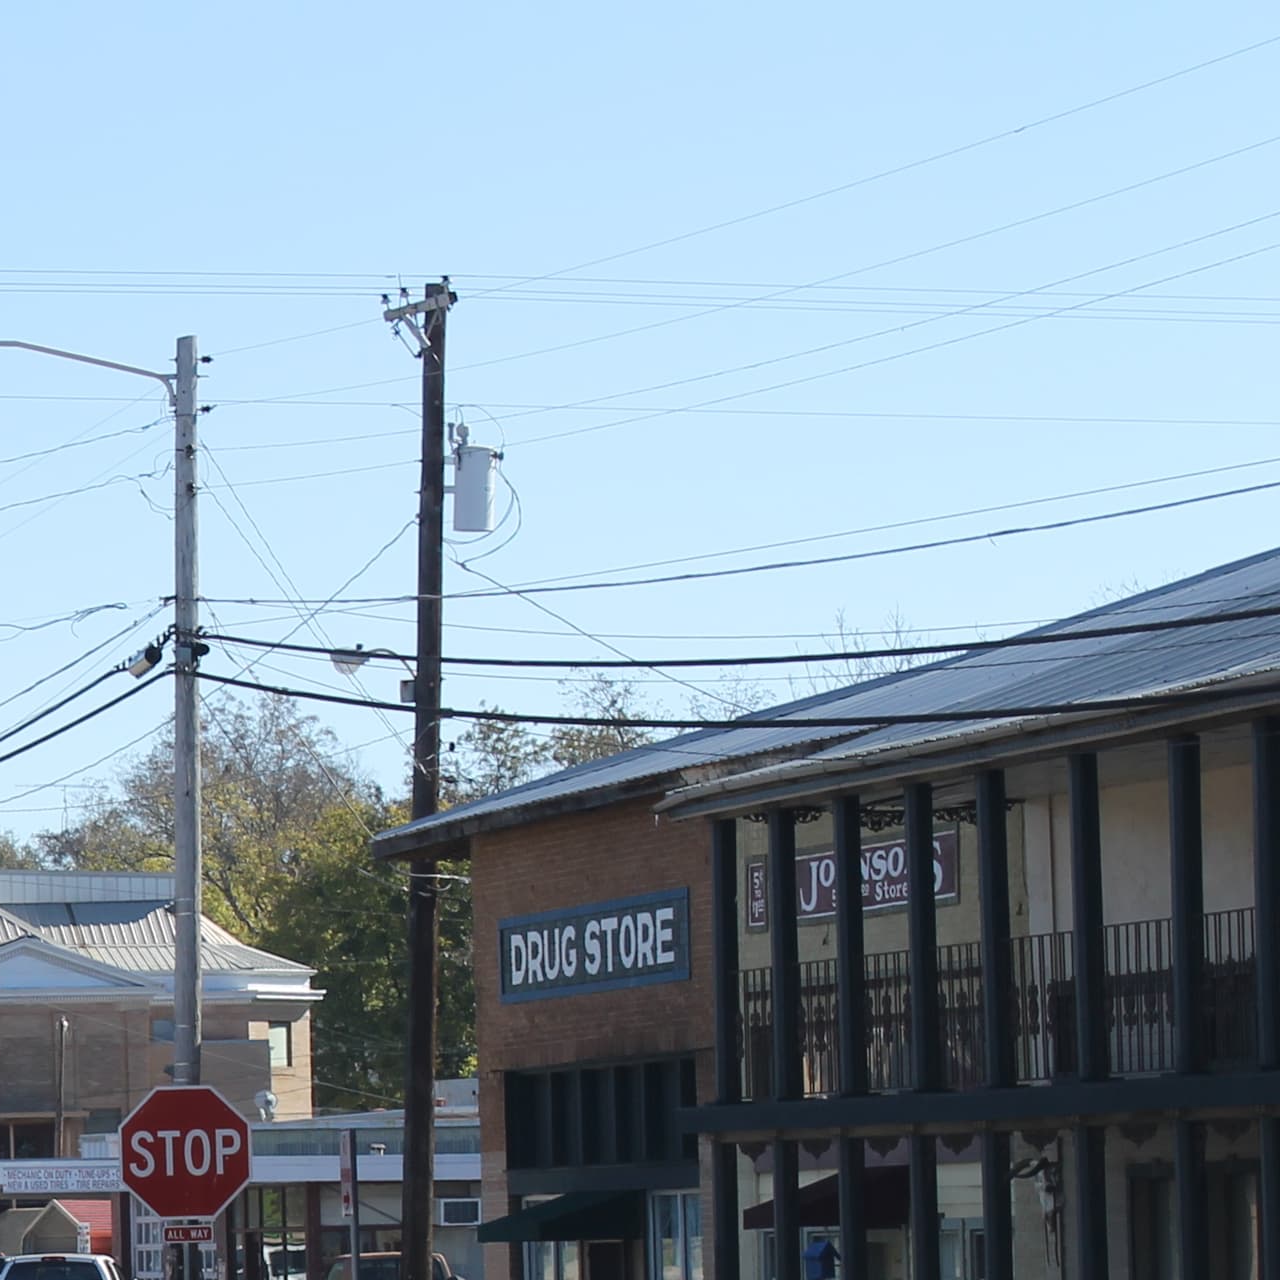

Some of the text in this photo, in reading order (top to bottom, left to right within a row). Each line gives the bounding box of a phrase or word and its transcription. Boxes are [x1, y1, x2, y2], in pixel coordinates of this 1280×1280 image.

[510, 908, 675, 985] DRUG STORE
[129, 1128, 241, 1178] STOP
[167, 1227, 209, 1240] ALL WAY
